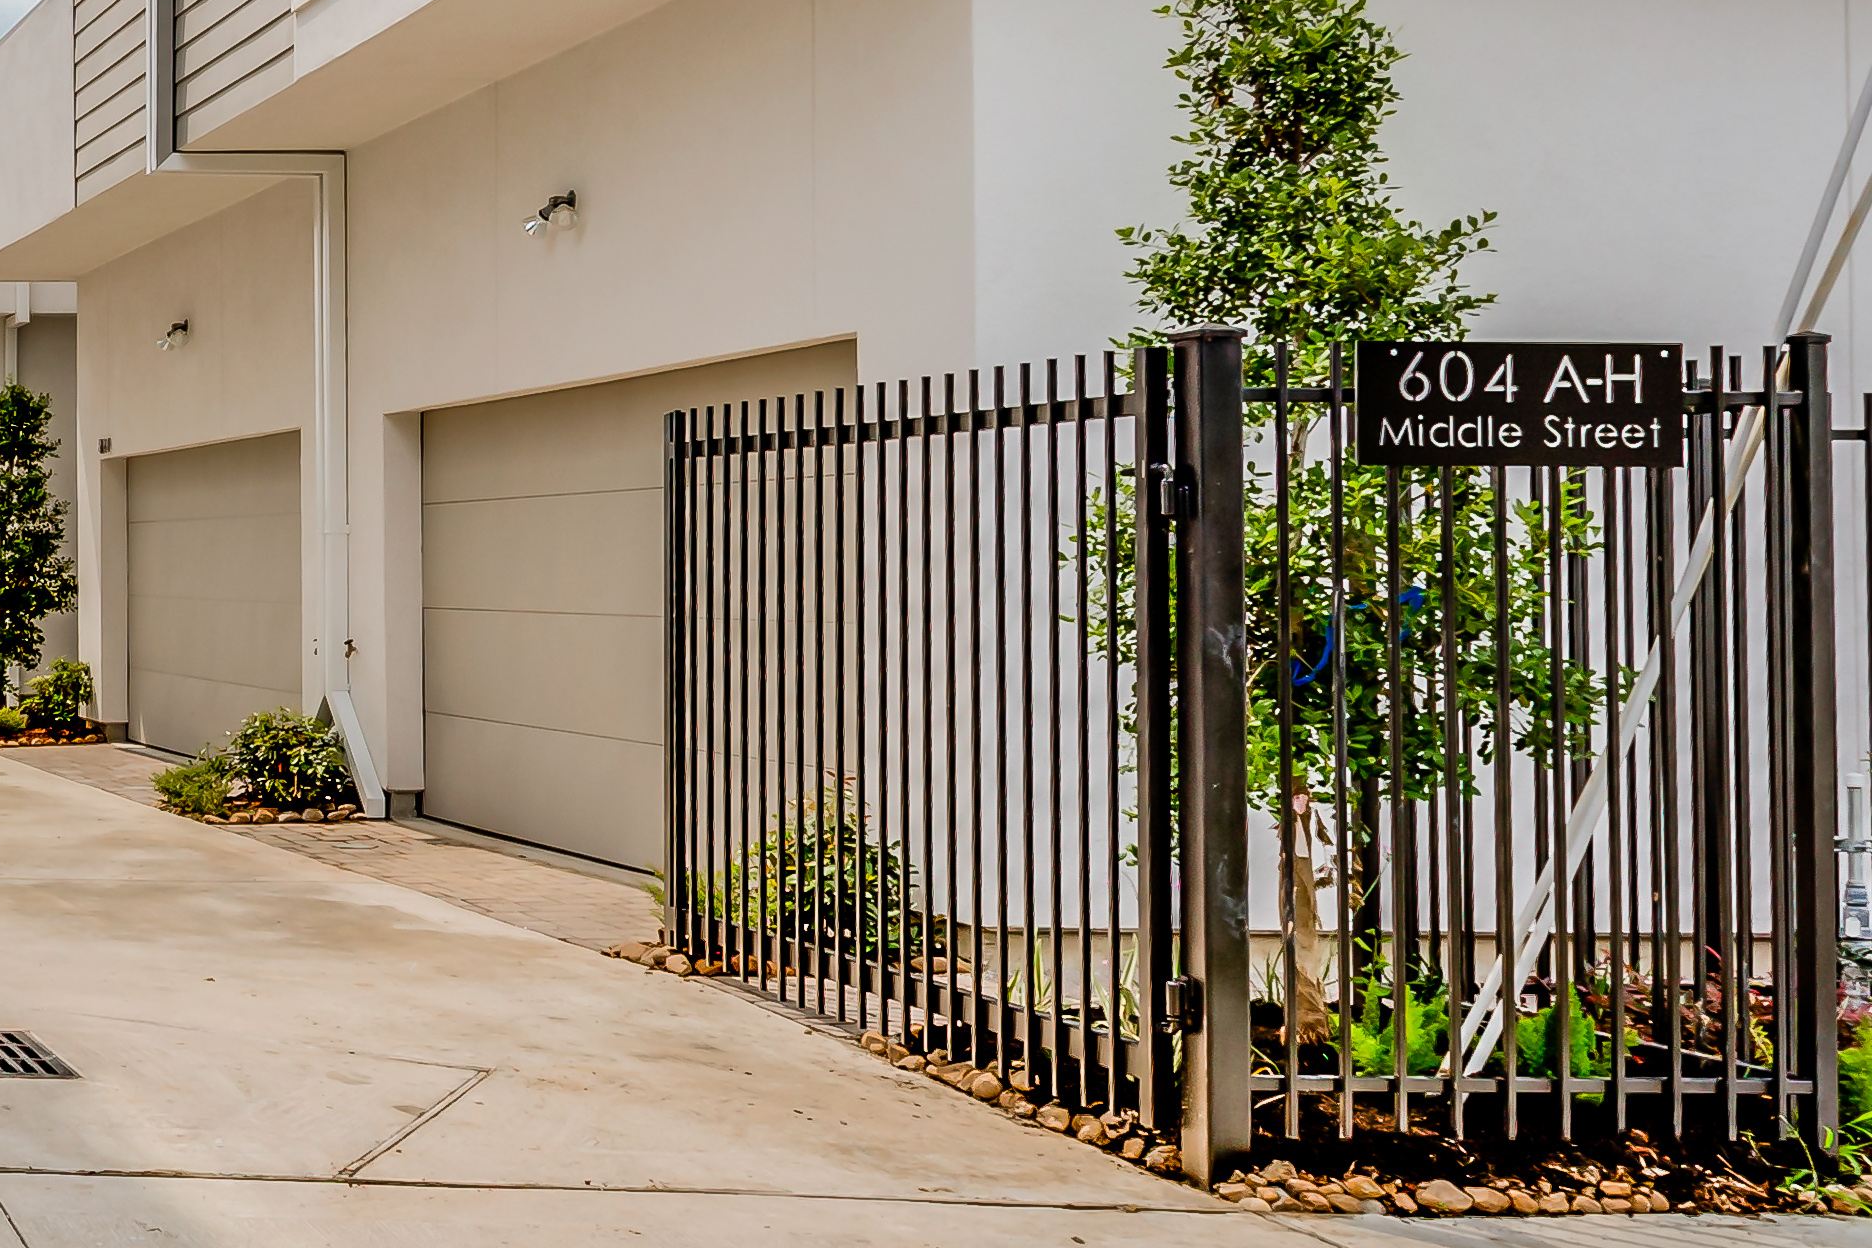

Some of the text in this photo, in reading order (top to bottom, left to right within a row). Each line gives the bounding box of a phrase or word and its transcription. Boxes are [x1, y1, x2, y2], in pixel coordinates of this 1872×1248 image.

[1398, 350, 1643, 404] 604 A-H
[1378, 414, 1662, 449] Middle Street
